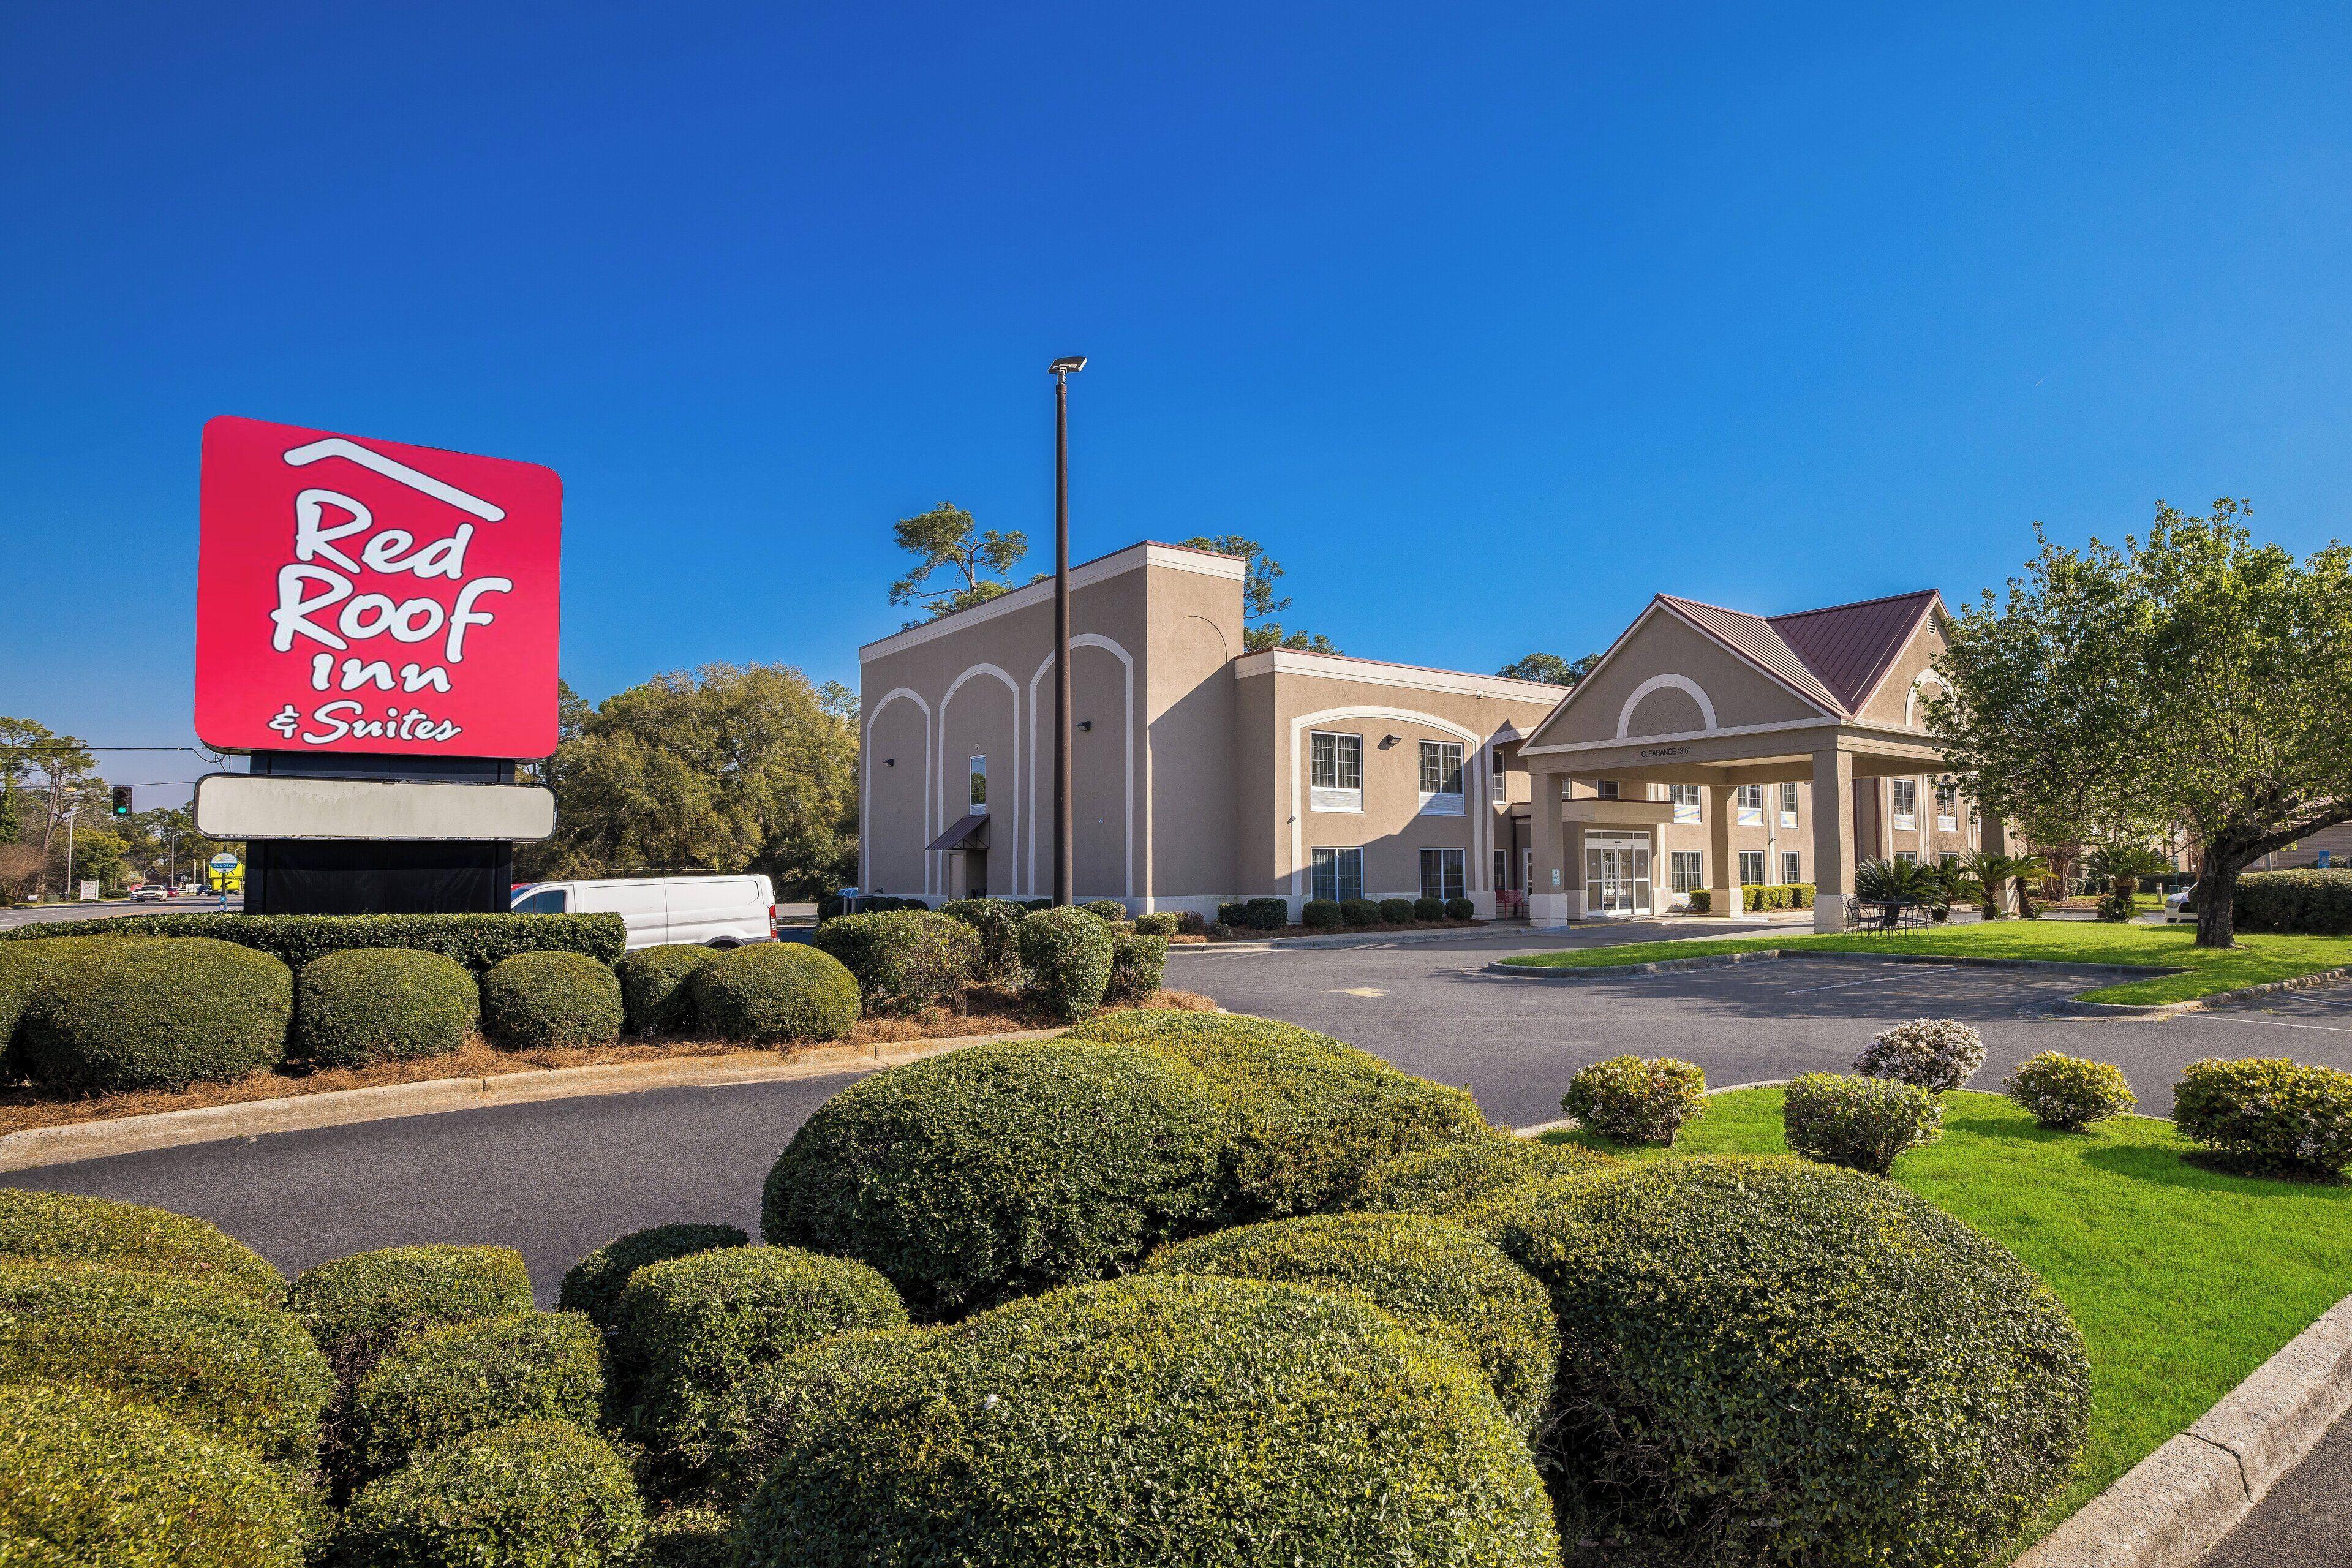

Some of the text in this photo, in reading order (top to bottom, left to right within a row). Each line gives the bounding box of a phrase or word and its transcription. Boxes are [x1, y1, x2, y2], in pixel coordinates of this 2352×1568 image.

[295, 488, 474, 579] Red
[269, 563, 513, 663] Roof
[268, 699, 462, 744] & Suites
[1642, 748, 1676, 758] CLEARANCE
